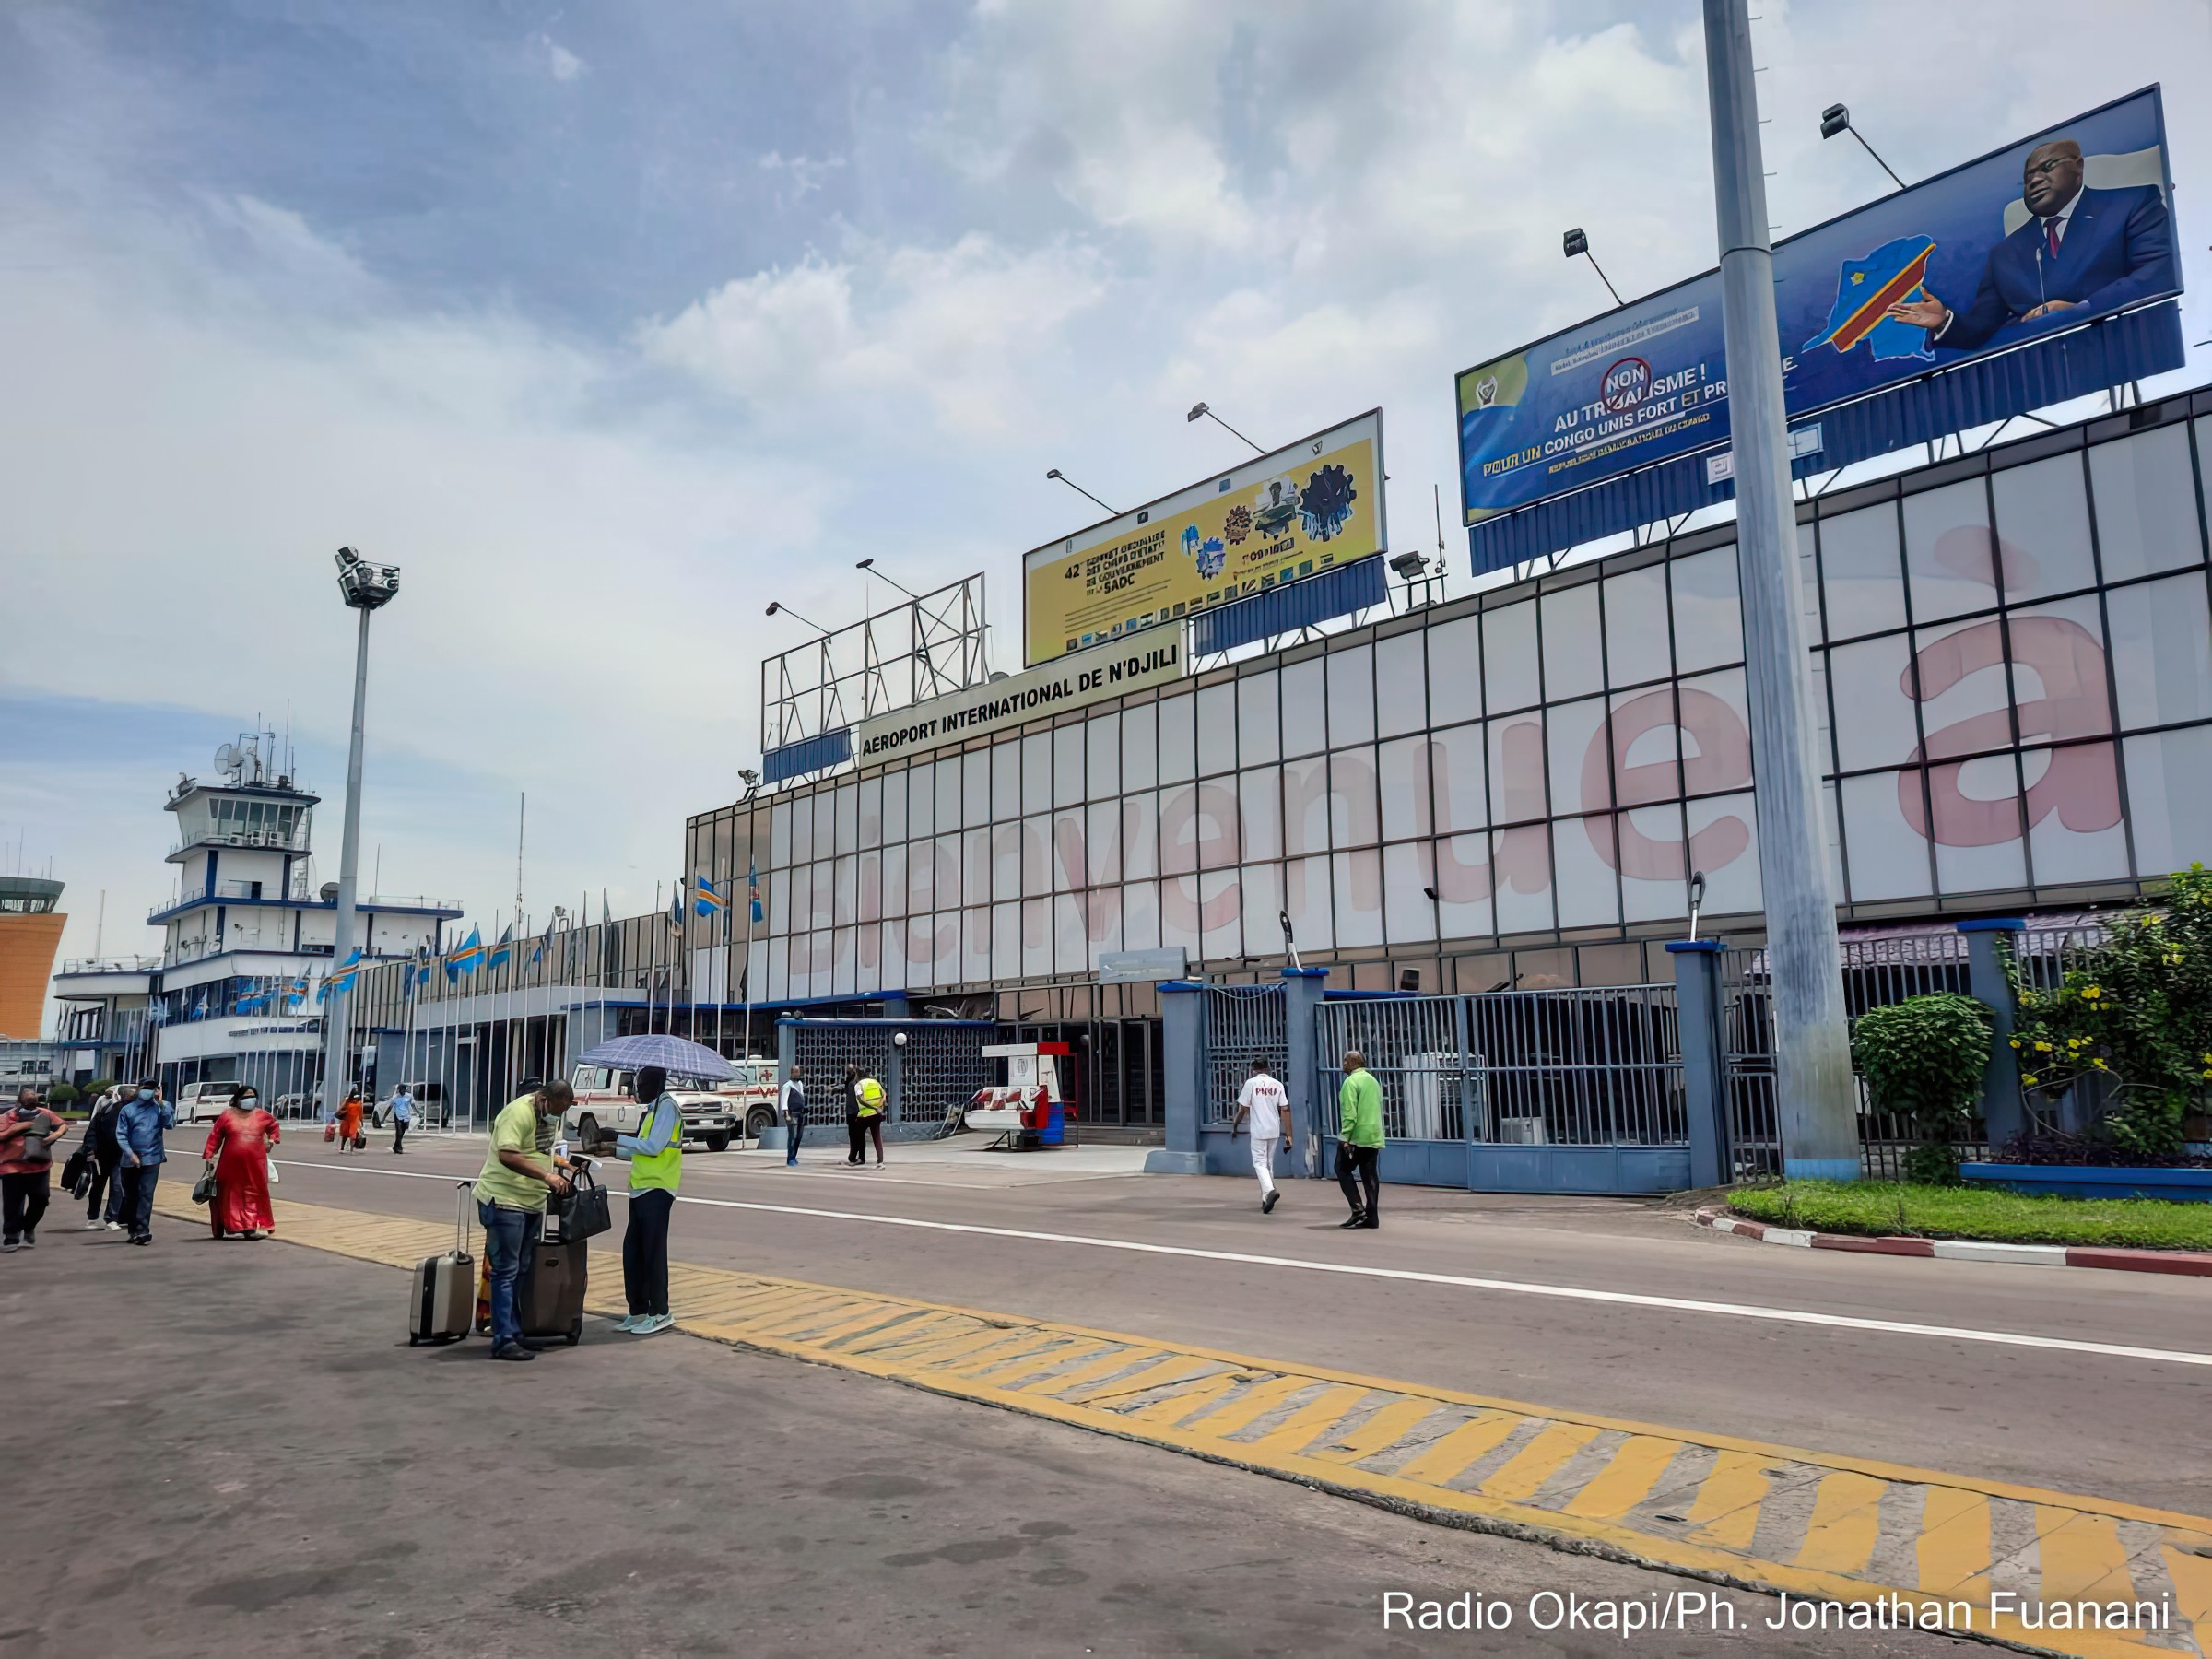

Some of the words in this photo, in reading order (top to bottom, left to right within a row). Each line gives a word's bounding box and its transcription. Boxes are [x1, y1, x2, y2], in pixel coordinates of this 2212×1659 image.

[1606, 364, 1646, 394] NON
[1483, 453, 1520, 477] POUR
[1522, 446, 1541, 465] UN
[1544, 428, 1594, 455] CONGO
[1598, 413, 1633, 436] UNIS
[1637, 397, 1678, 422] FORT
[1681, 388, 1701, 408] ET
[1554, 409, 1578, 432] AU
[1104, 572, 1135, 594] SADC
[862, 719, 937, 757] AÉROPORT
[942, 679, 1074, 734] INTERNATIONAL
[1078, 667, 1104, 691] DE
[1108, 644, 1177, 684] N'DJILI
[789, 688, 1751, 975] Bienvenue
[1899, 524, 2124, 847] à
